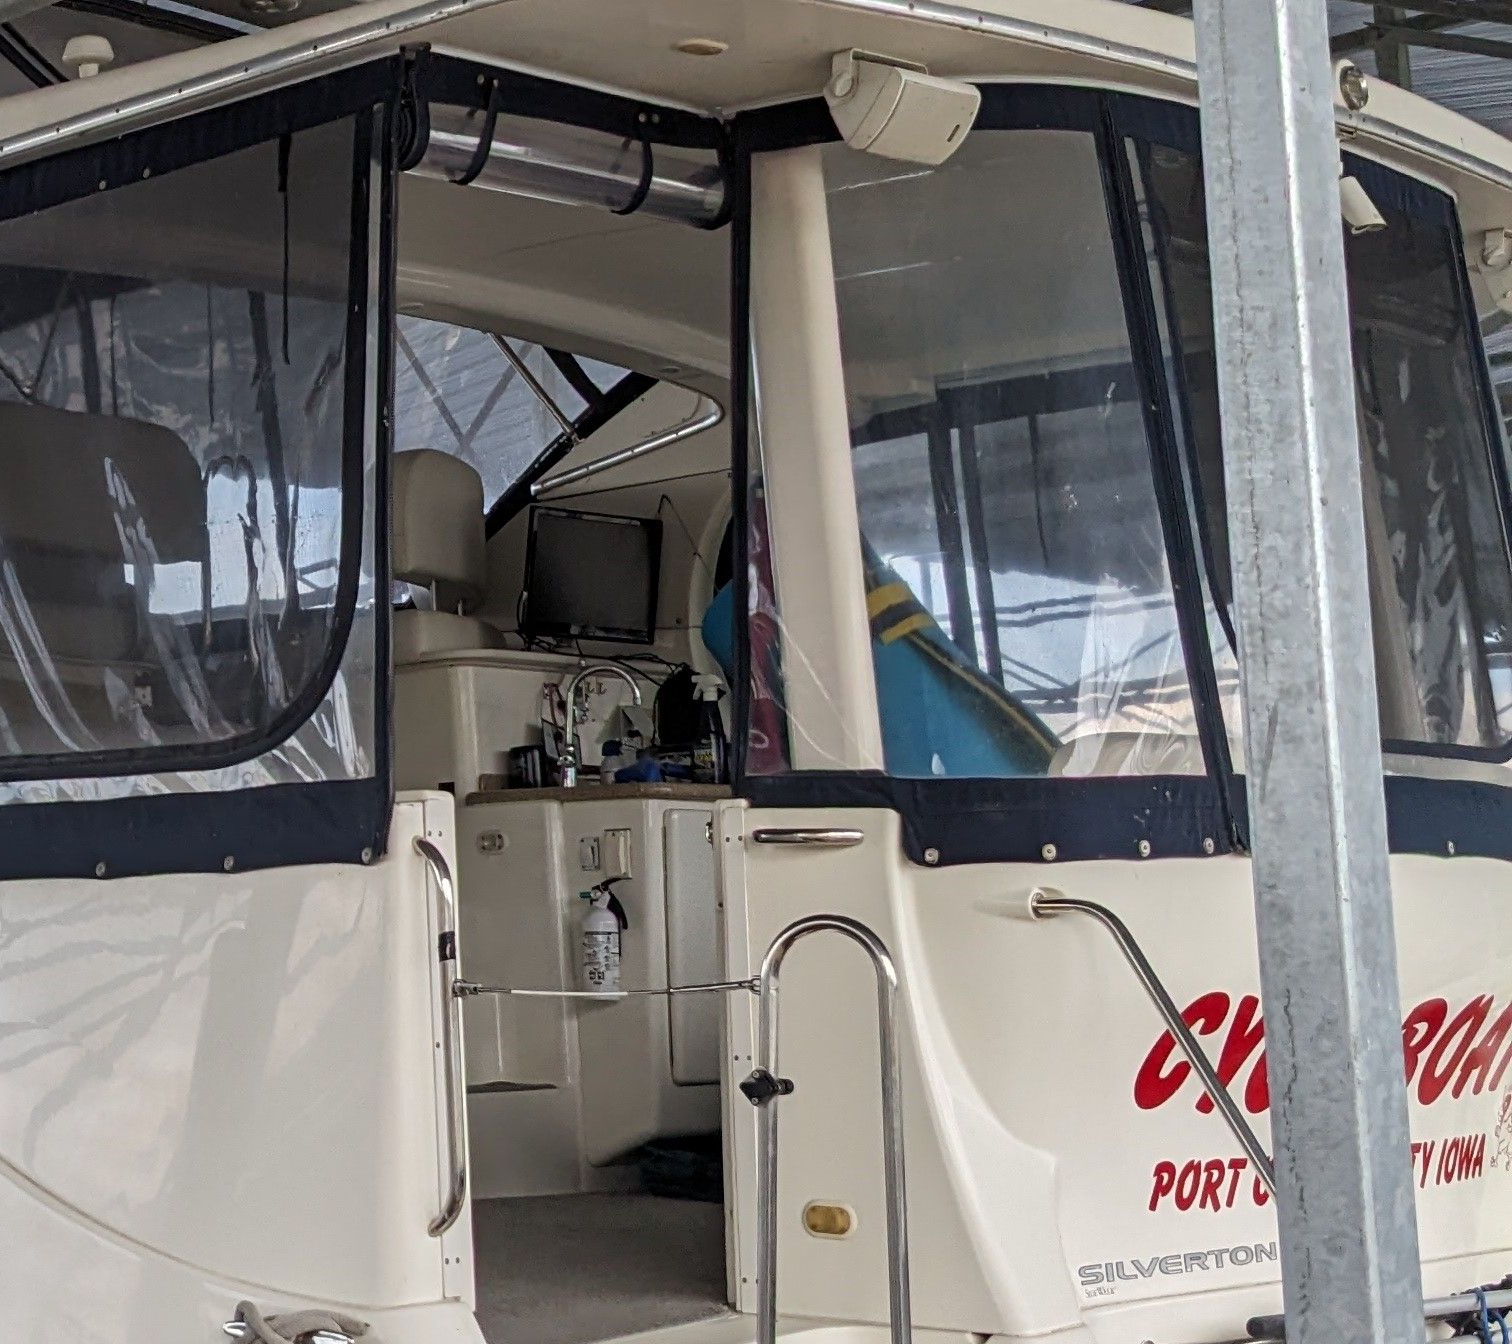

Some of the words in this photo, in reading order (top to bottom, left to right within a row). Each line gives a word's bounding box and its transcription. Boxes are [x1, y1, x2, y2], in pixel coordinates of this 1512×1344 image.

[1148, 1158, 1248, 1213] PORT
[1435, 1133, 1486, 1186] IOWA
[1078, 1242, 1278, 1286] SILVERTON
